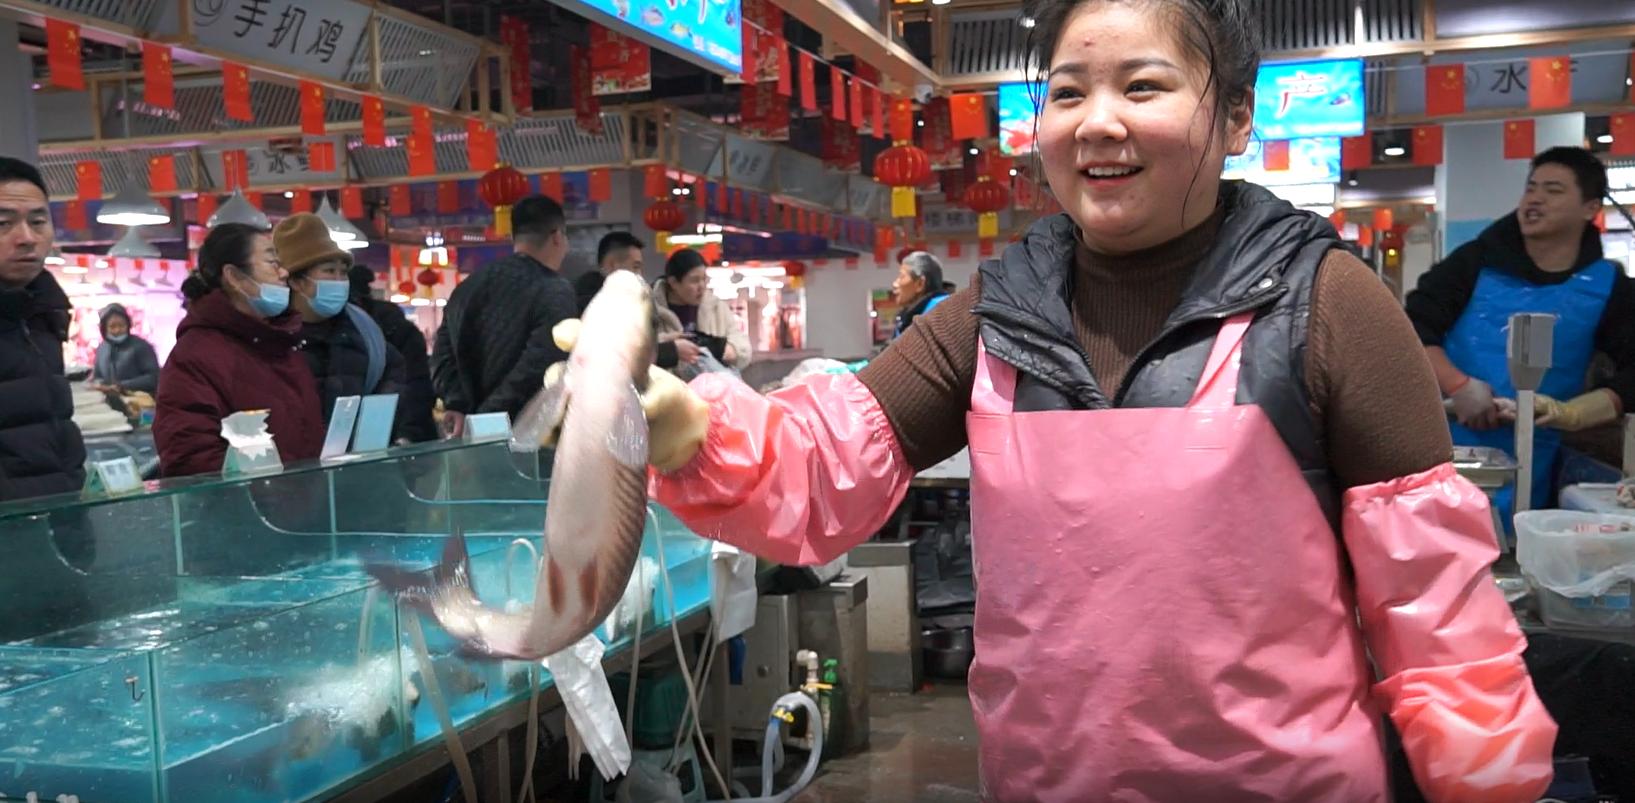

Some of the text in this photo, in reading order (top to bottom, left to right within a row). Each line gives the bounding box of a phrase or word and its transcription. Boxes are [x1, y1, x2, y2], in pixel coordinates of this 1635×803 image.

[233, 0, 344, 63] 手扒鸡
[1276, 71, 1328, 120] 产
